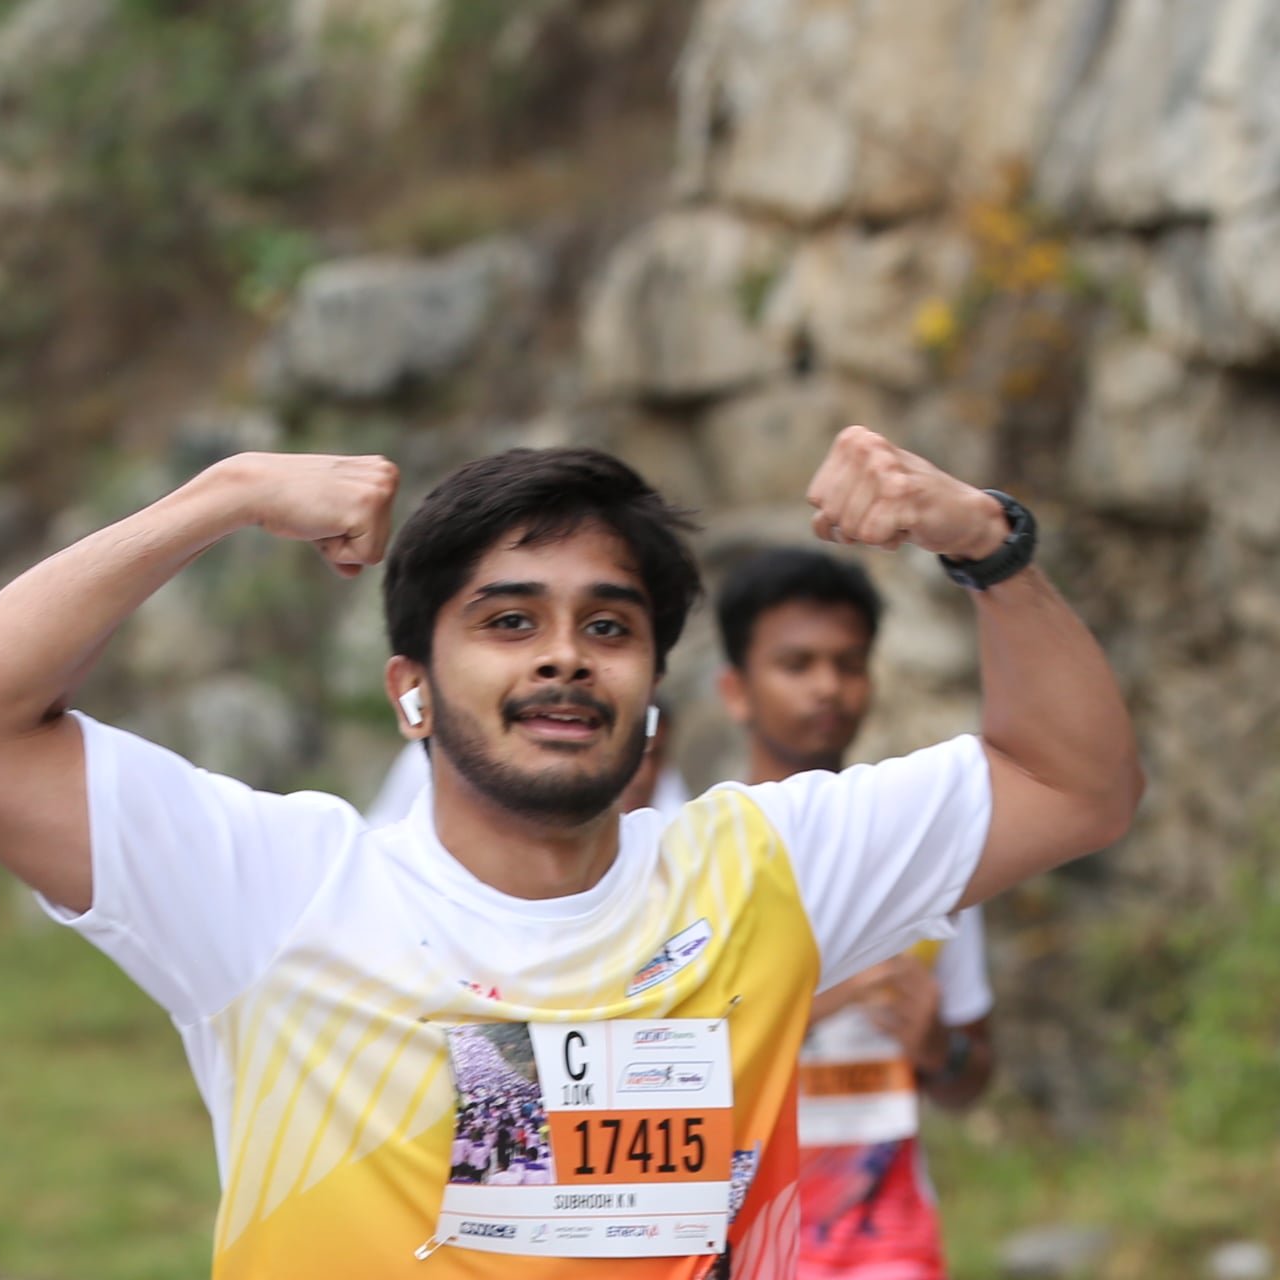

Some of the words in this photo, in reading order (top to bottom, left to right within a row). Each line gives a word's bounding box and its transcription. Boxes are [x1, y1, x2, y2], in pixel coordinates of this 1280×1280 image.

[565, 1030, 587, 1081] C
[561, 1083, 595, 1106] 10K
[574, 1117, 705, 1176] 17415
